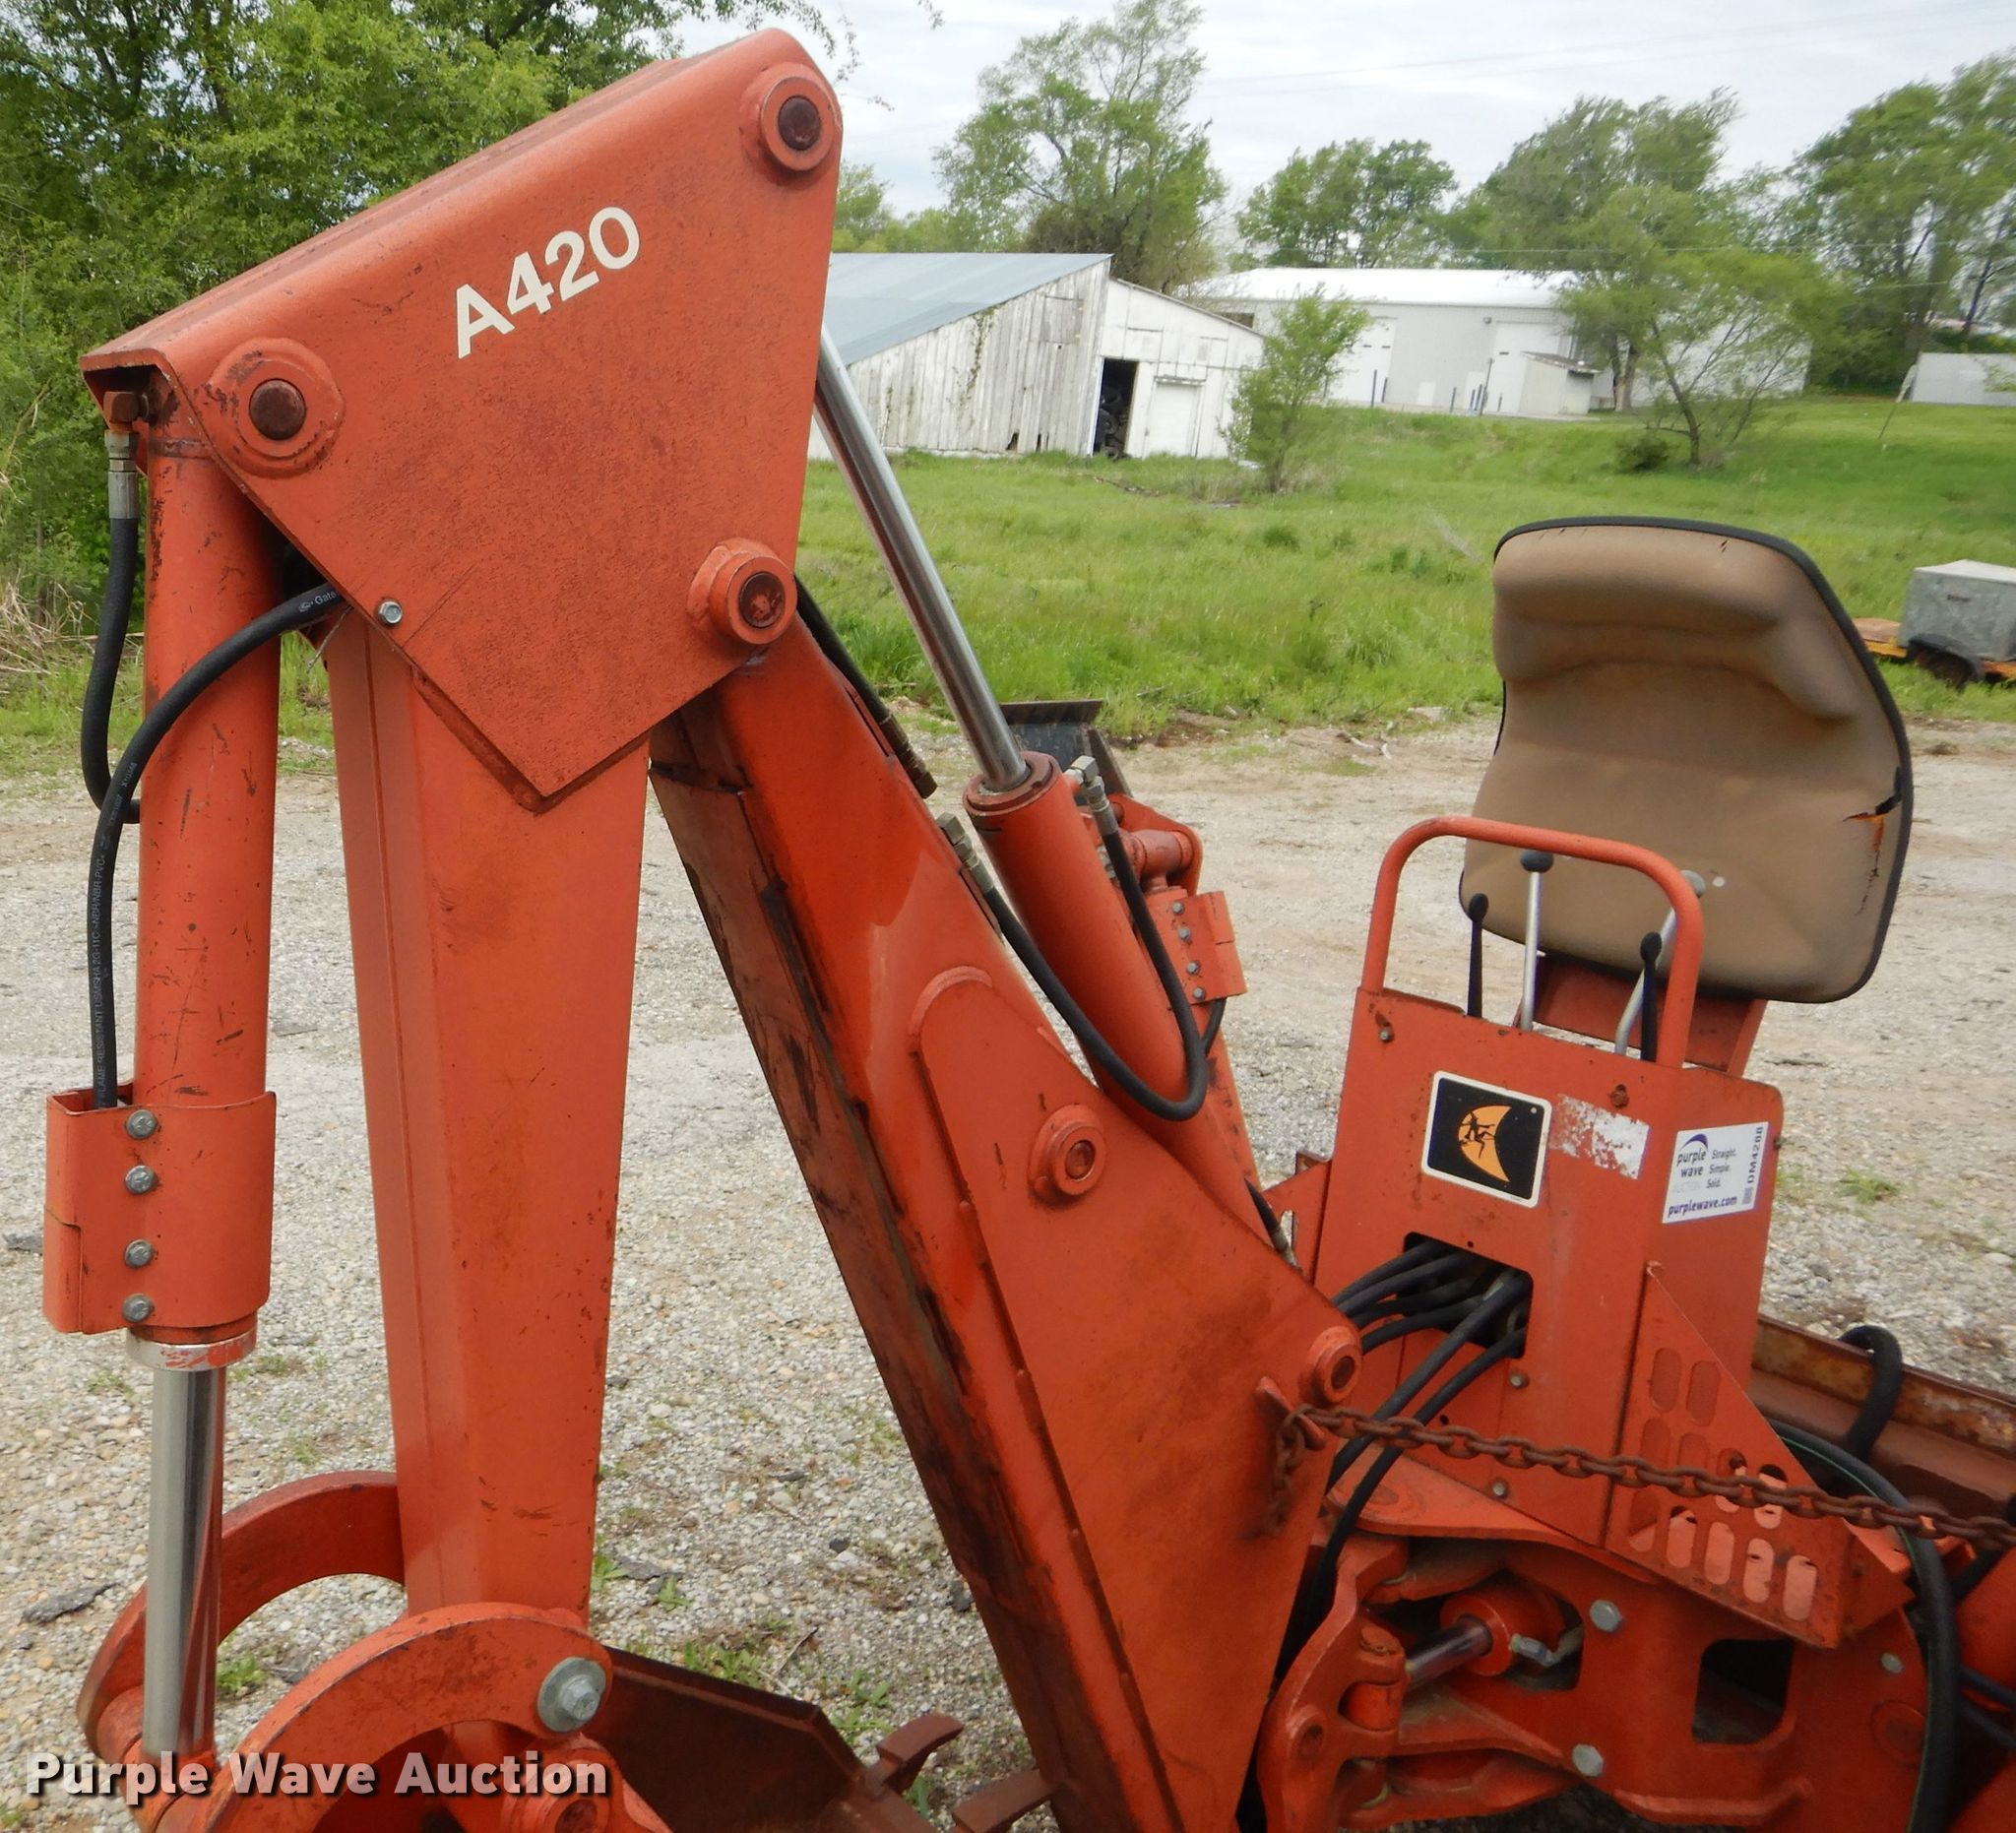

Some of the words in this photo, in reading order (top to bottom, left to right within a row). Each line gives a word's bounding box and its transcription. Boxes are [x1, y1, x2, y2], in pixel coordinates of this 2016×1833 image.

[457, 207, 640, 359] A420
[1676, 1148, 1707, 1167] purple
[1680, 1166, 1704, 1178] wave
[1668, 1196, 1737, 1218] purplewave.com
